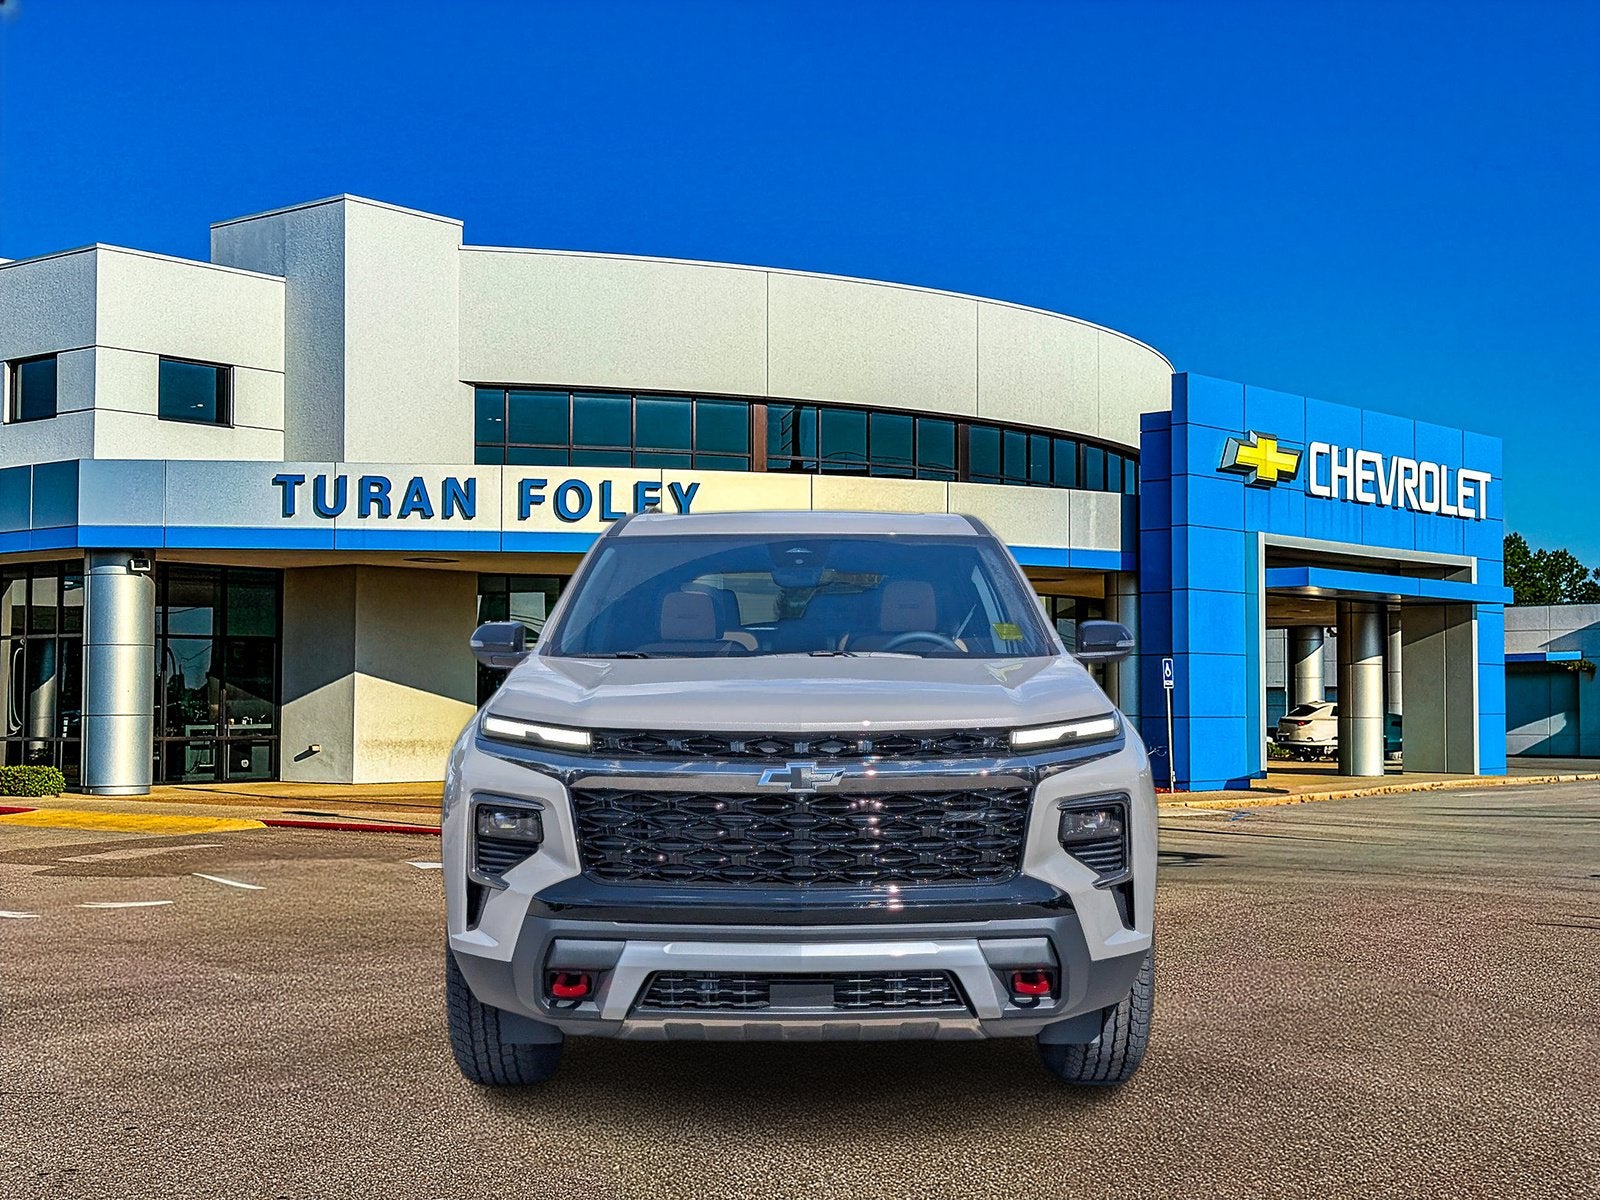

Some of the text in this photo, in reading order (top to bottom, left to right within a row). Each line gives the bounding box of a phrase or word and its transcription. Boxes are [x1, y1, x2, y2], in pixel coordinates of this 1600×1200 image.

[272, 474, 701, 523] TURAN FOLEY
[1306, 441, 1492, 521] CHEVROLET
